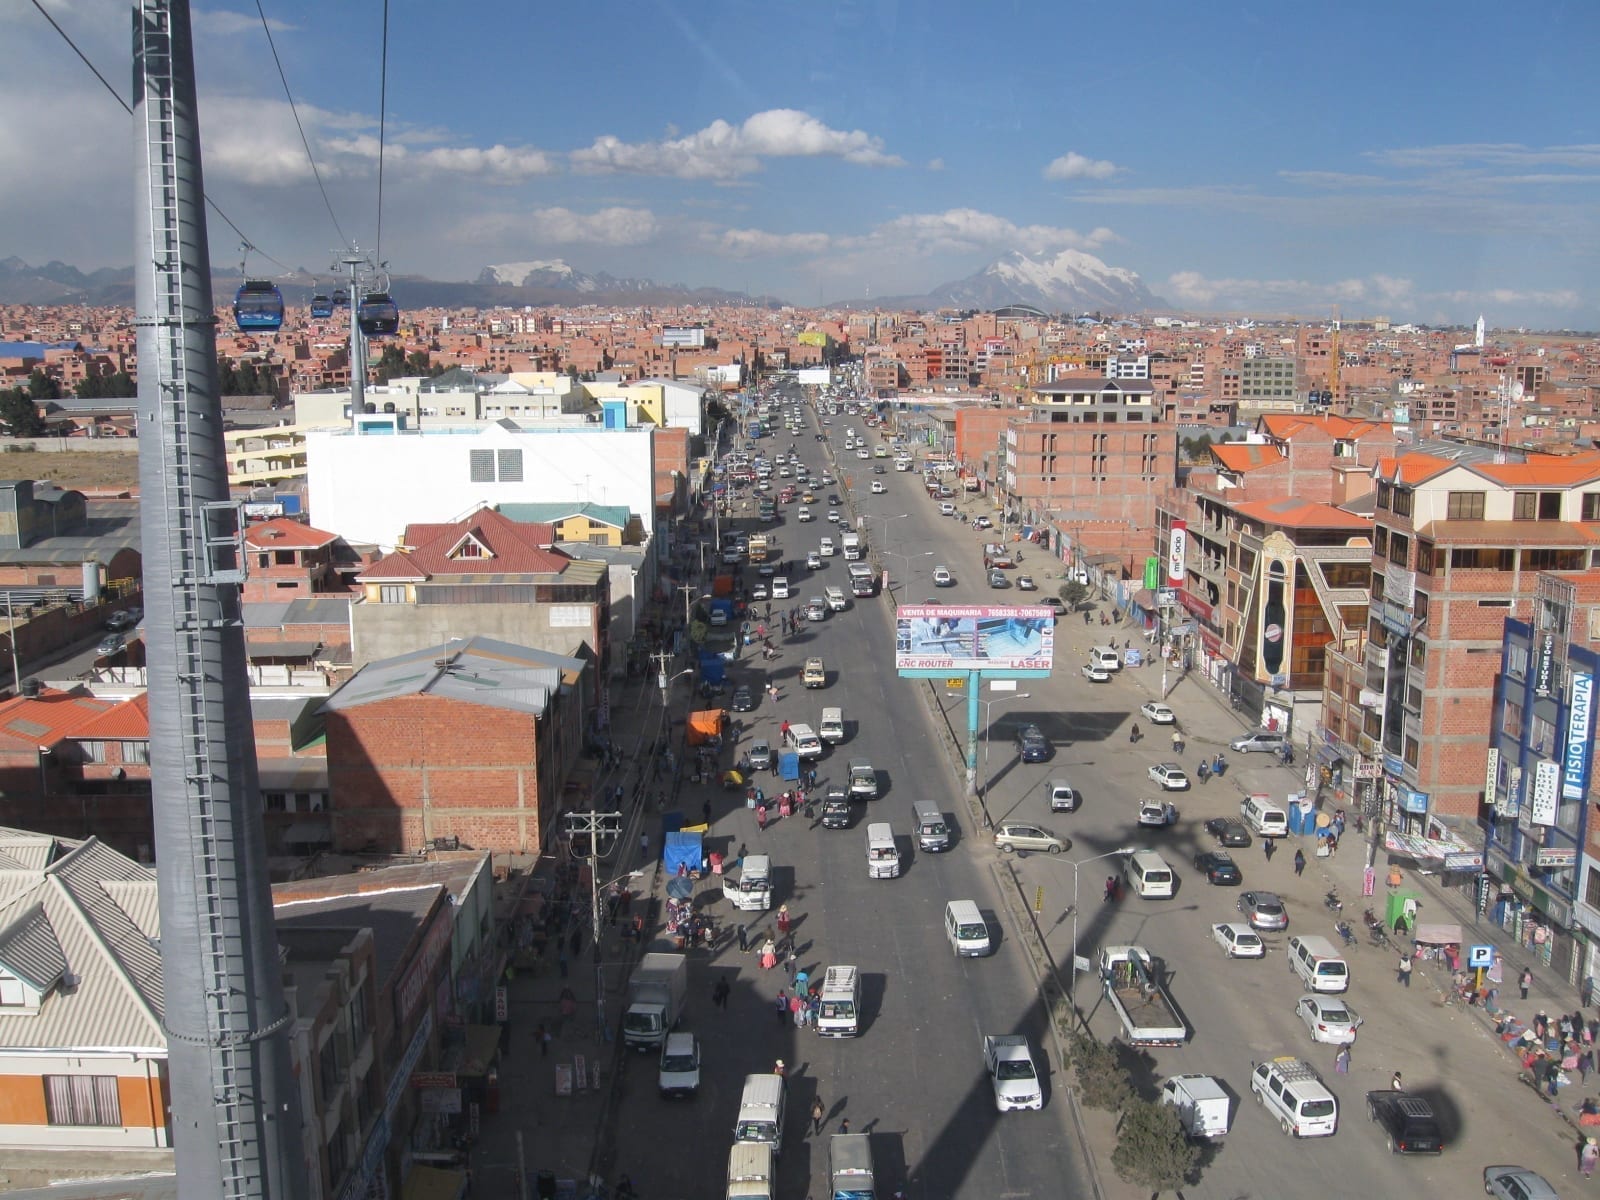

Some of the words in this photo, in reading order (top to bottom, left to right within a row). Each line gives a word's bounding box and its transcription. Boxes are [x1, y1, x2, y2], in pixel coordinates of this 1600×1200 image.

[1543, 636, 1553, 655] FOTO
[1540, 656, 1550, 690] ESTUDIO
[1487, 750, 1496, 802] ECOGRAFIA
[1476, 950, 1487, 960] P
